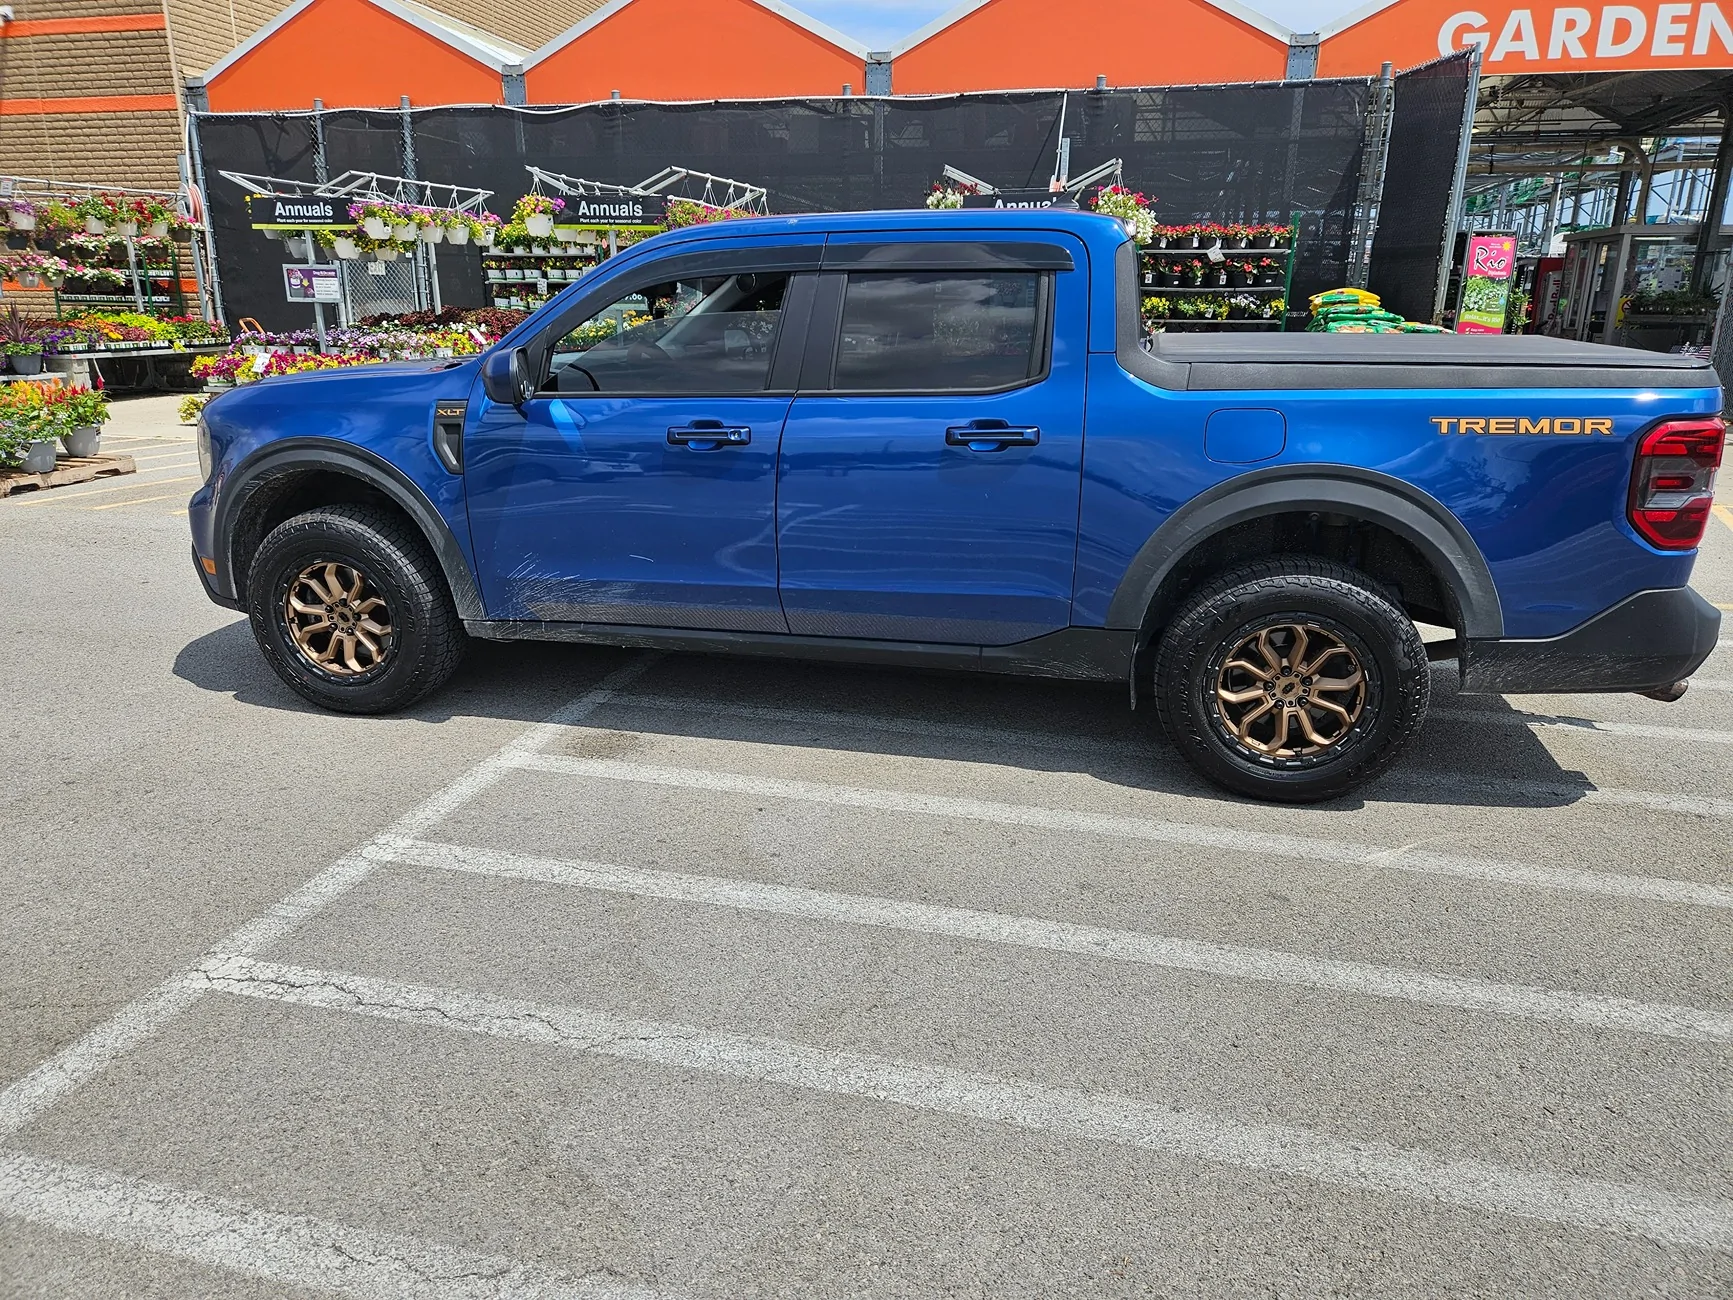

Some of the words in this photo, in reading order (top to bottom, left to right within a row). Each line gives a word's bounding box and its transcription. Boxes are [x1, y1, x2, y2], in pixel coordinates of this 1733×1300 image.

[1437, 2, 1733, 62] GARDEN
[275, 201, 333, 217] Annuals
[578, 200, 642, 216] Annuals
[1474, 246, 1507, 272] Rio
[436, 408, 465, 416] XLT
[1430, 417, 1614, 435] TREMOR
